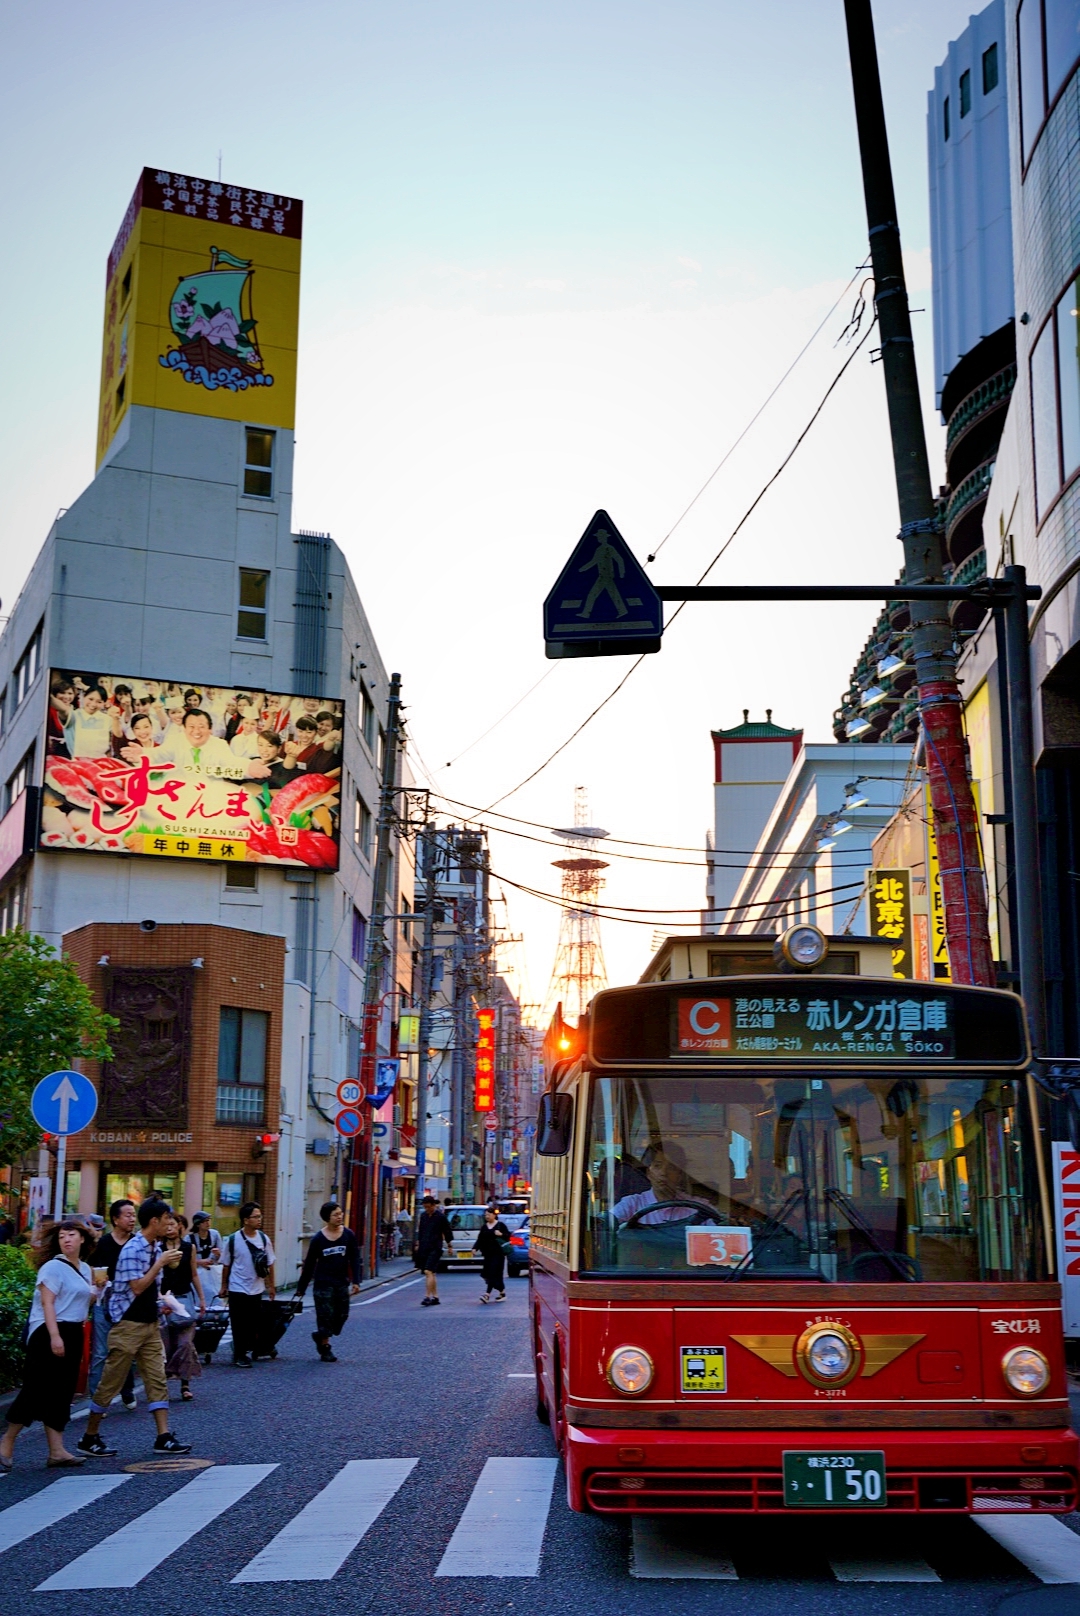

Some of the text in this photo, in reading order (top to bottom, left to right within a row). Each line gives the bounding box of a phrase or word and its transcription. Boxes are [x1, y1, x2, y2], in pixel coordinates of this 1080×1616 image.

[165, 824, 249, 838] SUSHIZANMAI
[153, 838, 235, 857] 年中無休
[735, 998, 800, 1013] 港の見える
[690, 1001, 720, 1035] C
[735, 1013, 775, 1029] 丘公園
[806, 999, 947, 1031] 赤レンガ倉庫
[812, 1042, 895, 1052] AKA-RENGA
[342, 1086, 359, 1099] 30
[90, 1132, 193, 1142] KOBAN POLICE
[710, 1239, 727, 1261] 3
[991, 1320, 1041, 1333] 宝くじ号
